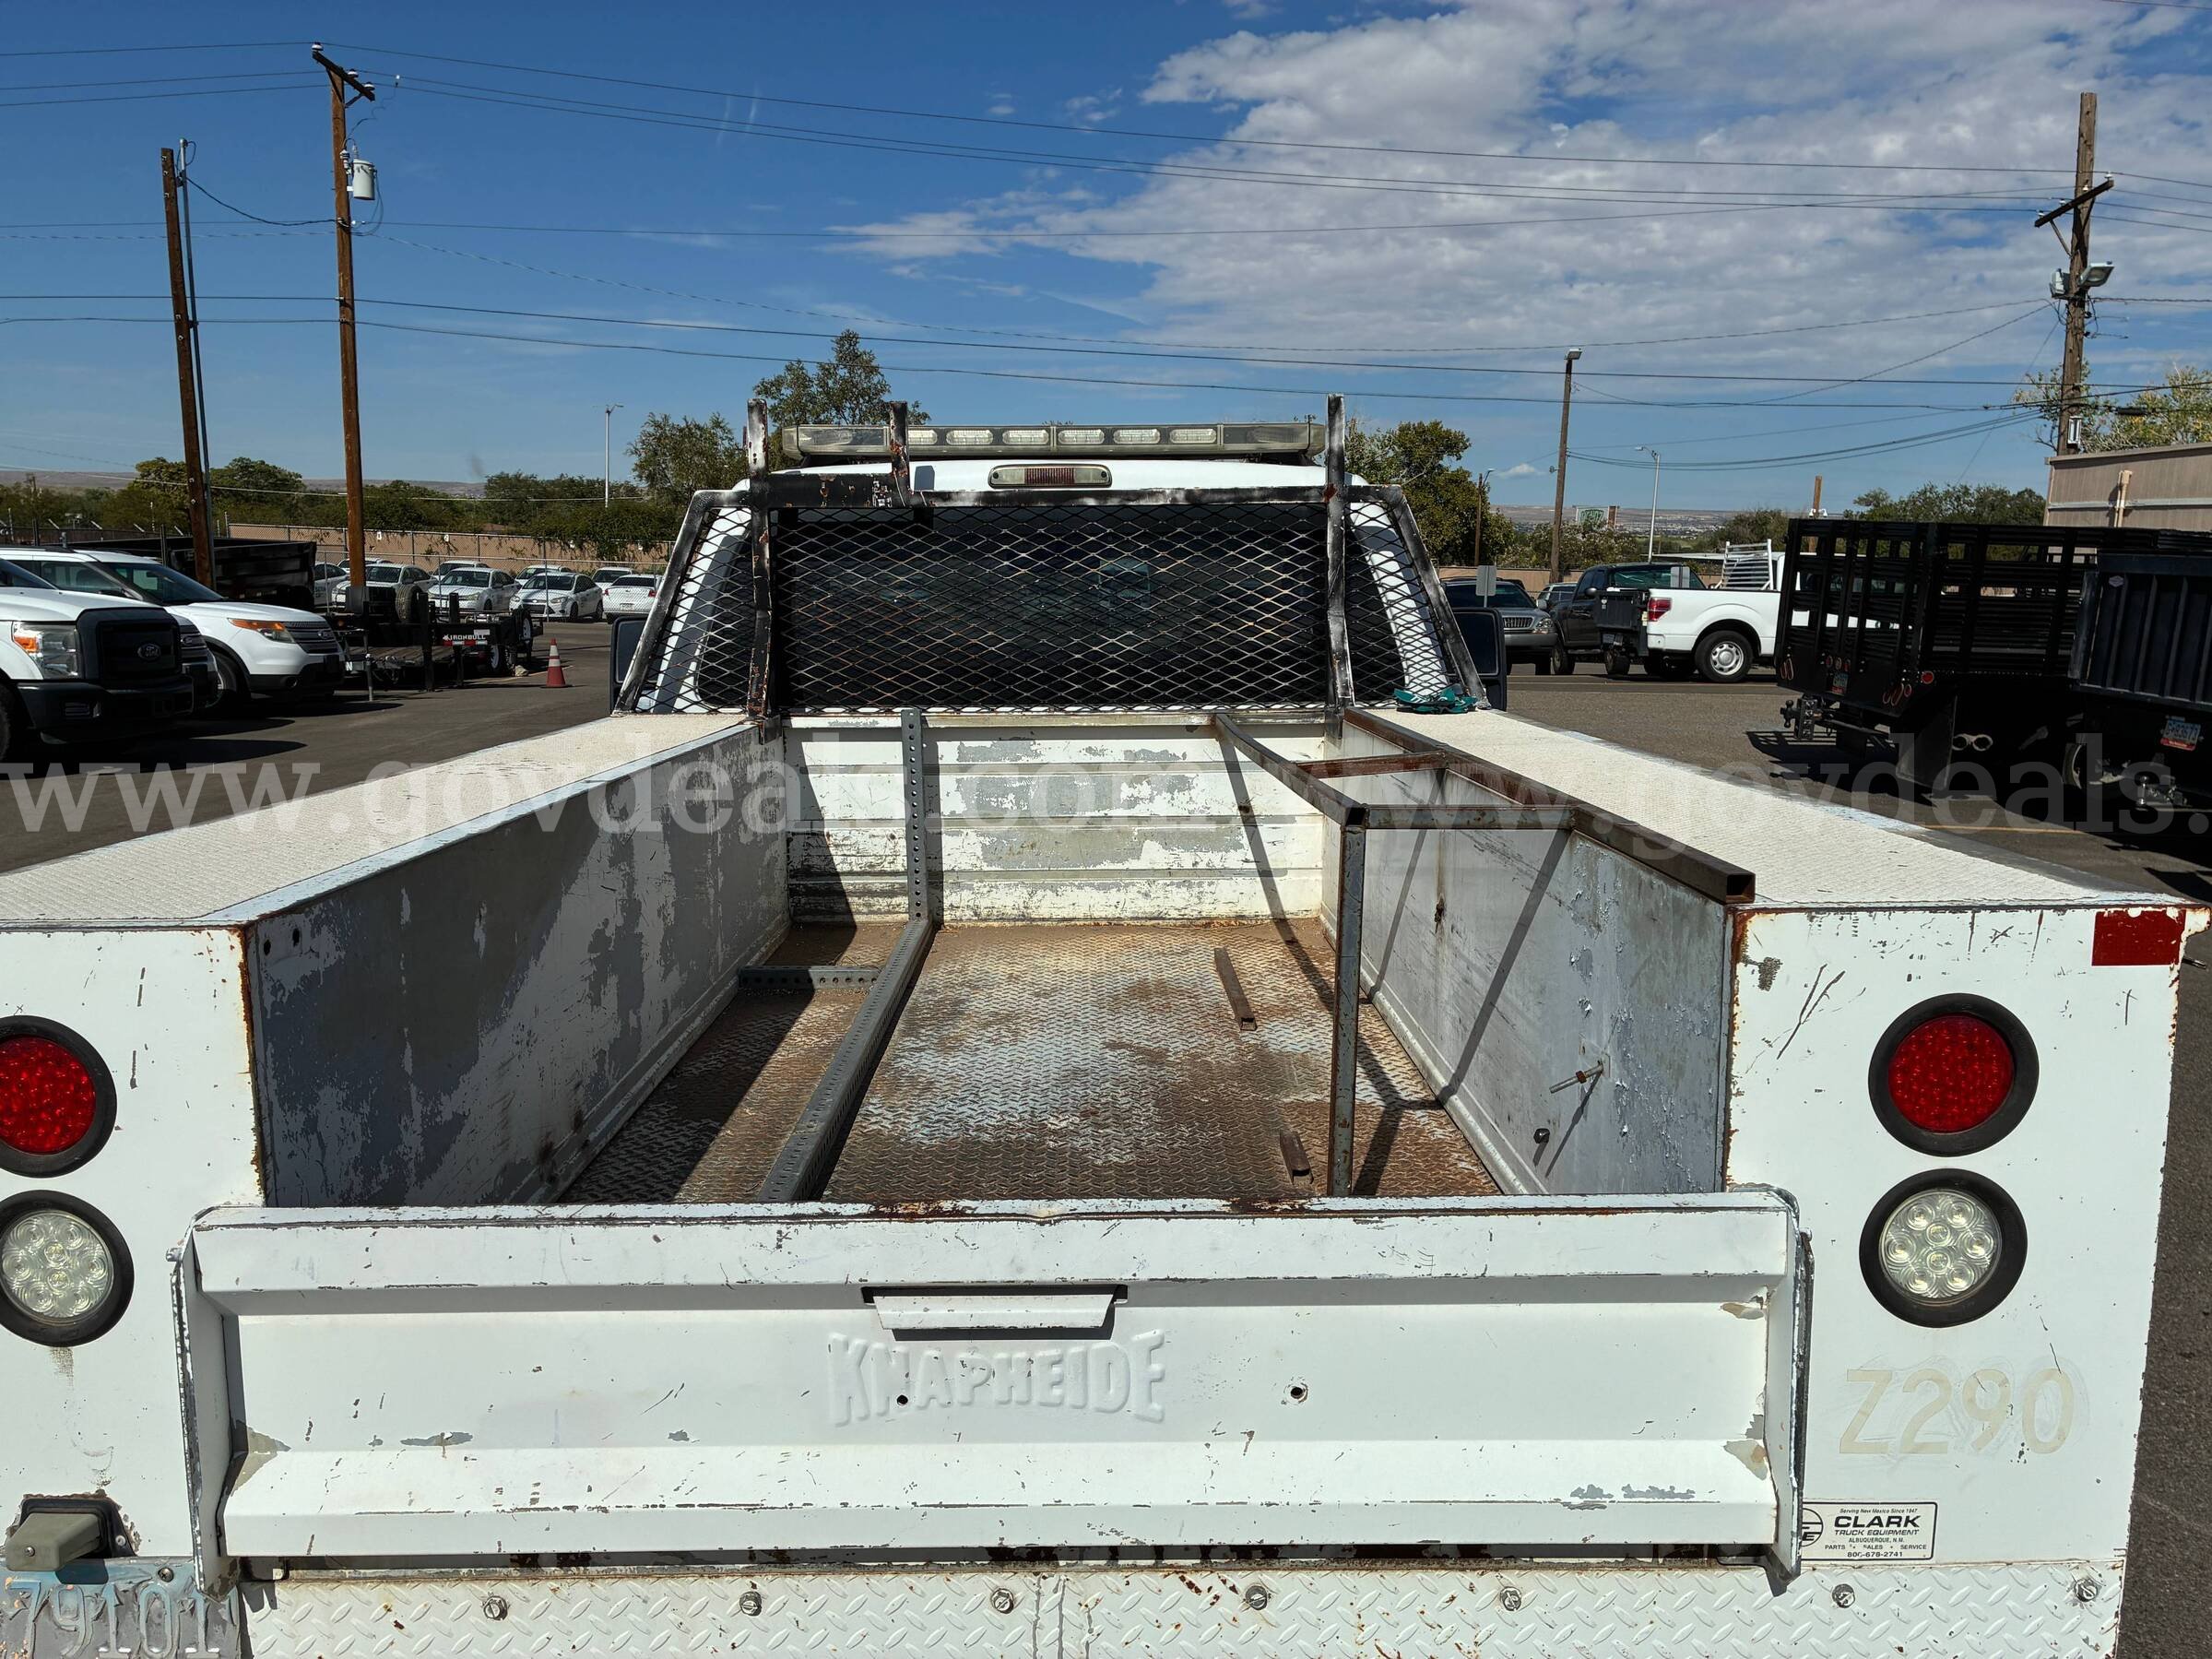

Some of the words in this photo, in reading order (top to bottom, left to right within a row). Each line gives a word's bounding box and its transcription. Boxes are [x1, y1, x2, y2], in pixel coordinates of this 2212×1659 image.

[829, 1328, 1166, 1428] KNAPHEIDE
[1839, 1368, 2075, 1455] Z290
[1834, 1515, 1922, 1528] CLARK
